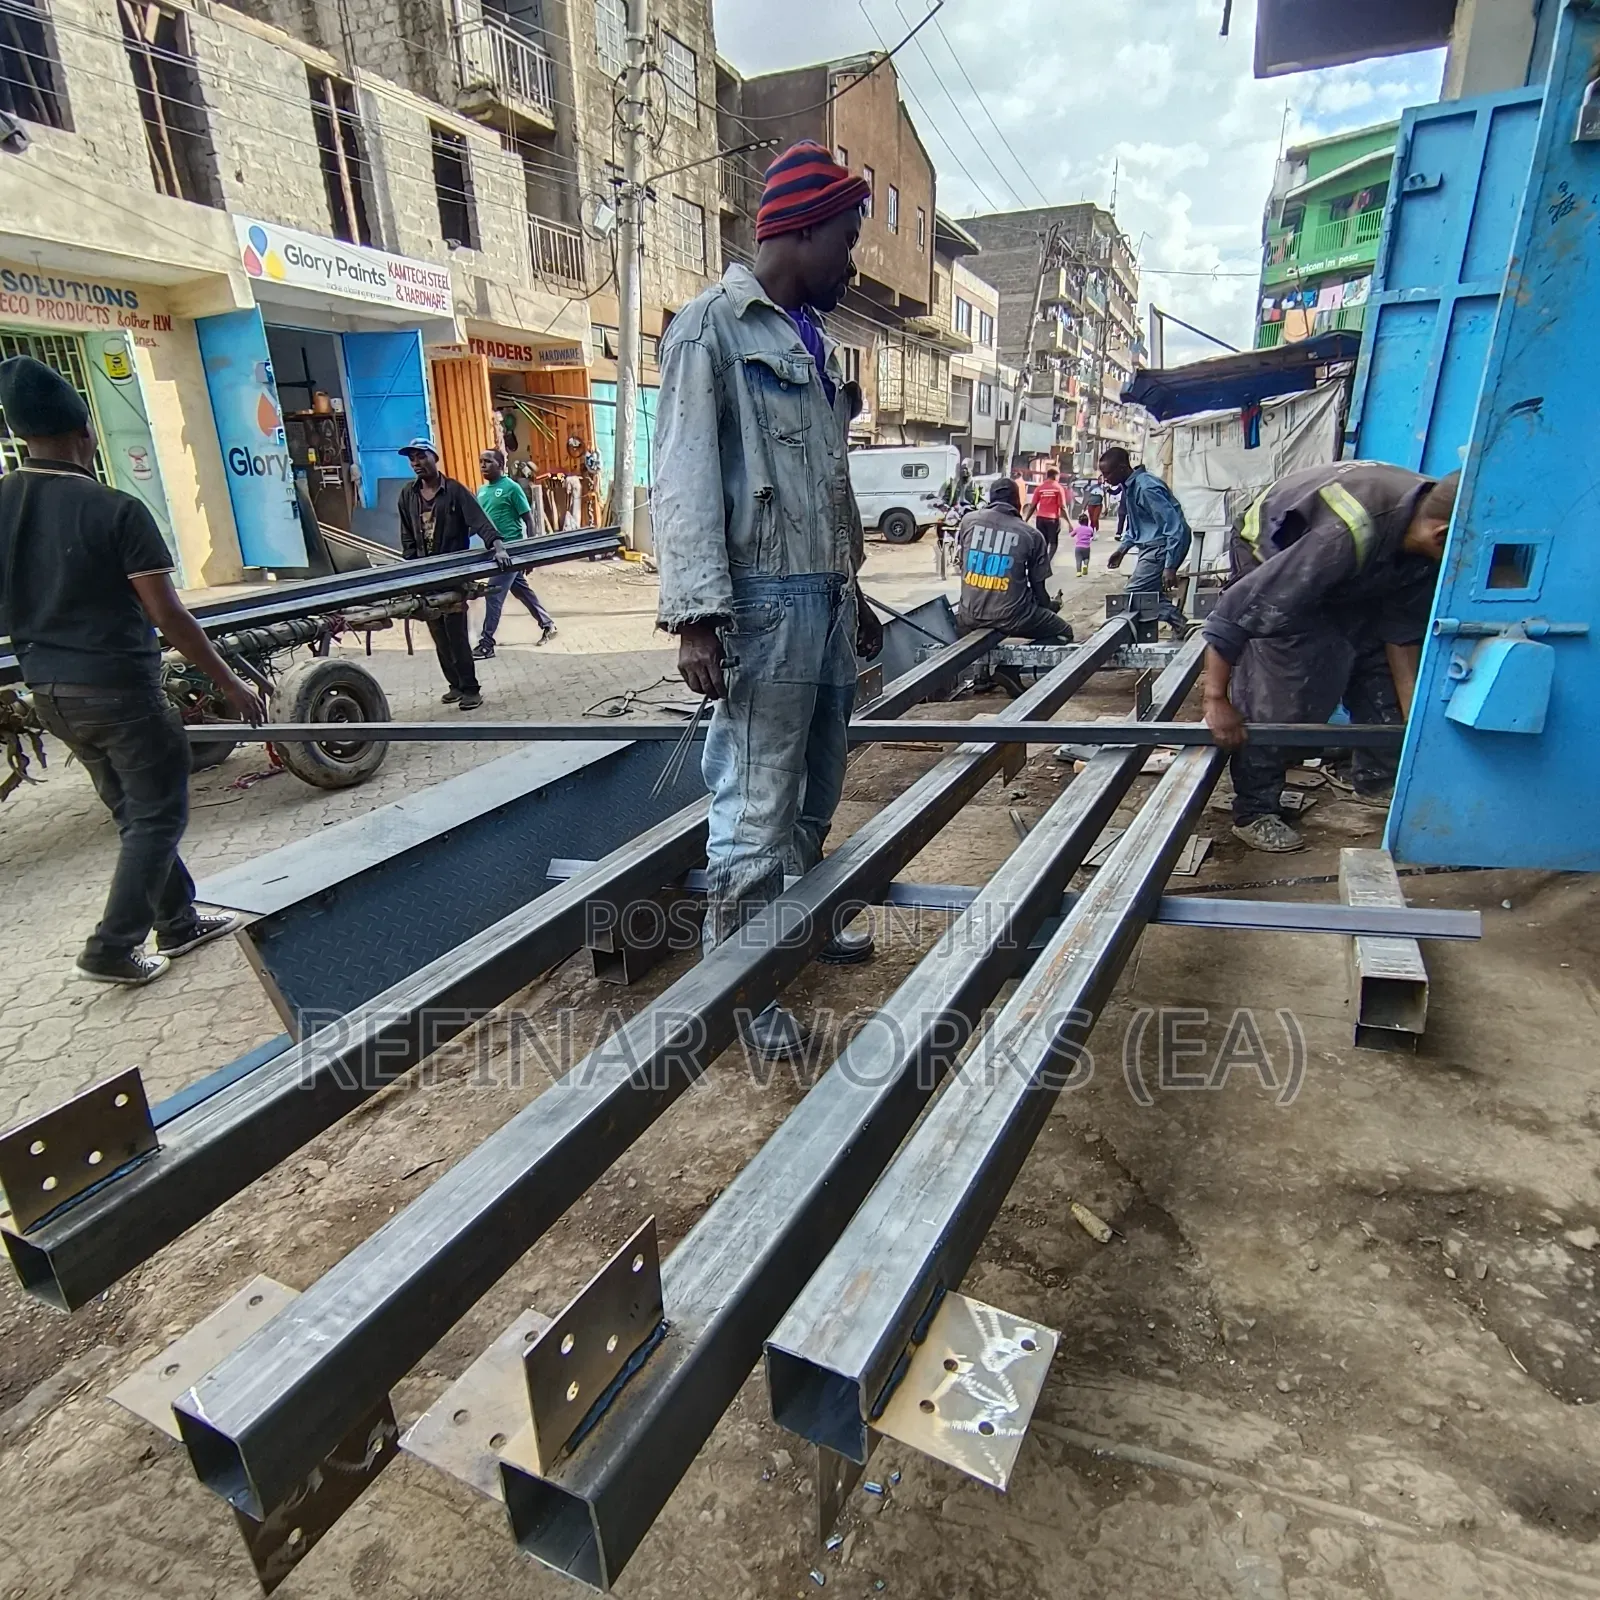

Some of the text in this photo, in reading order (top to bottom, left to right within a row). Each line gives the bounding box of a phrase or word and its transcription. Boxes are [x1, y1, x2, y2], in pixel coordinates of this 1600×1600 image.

[284, 244, 387, 286] Glory Paints
[387, 261, 451, 291] KAMTECH STEEL
[1, 269, 139, 309] SOLUTIONS
[396, 285, 404, 301] &
[404, 289, 447, 310] HARDWARE
[36, 299, 110, 325] PRODUCTS
[468, 338, 533, 362] TRADERS
[539, 347, 581, 362] HARDWARE
[229, 446, 288, 482] Glory
[970, 525, 1019, 555] FLIP
[967, 550, 1014, 577] FLOP
[965, 571, 1009, 591] SOUNDS
